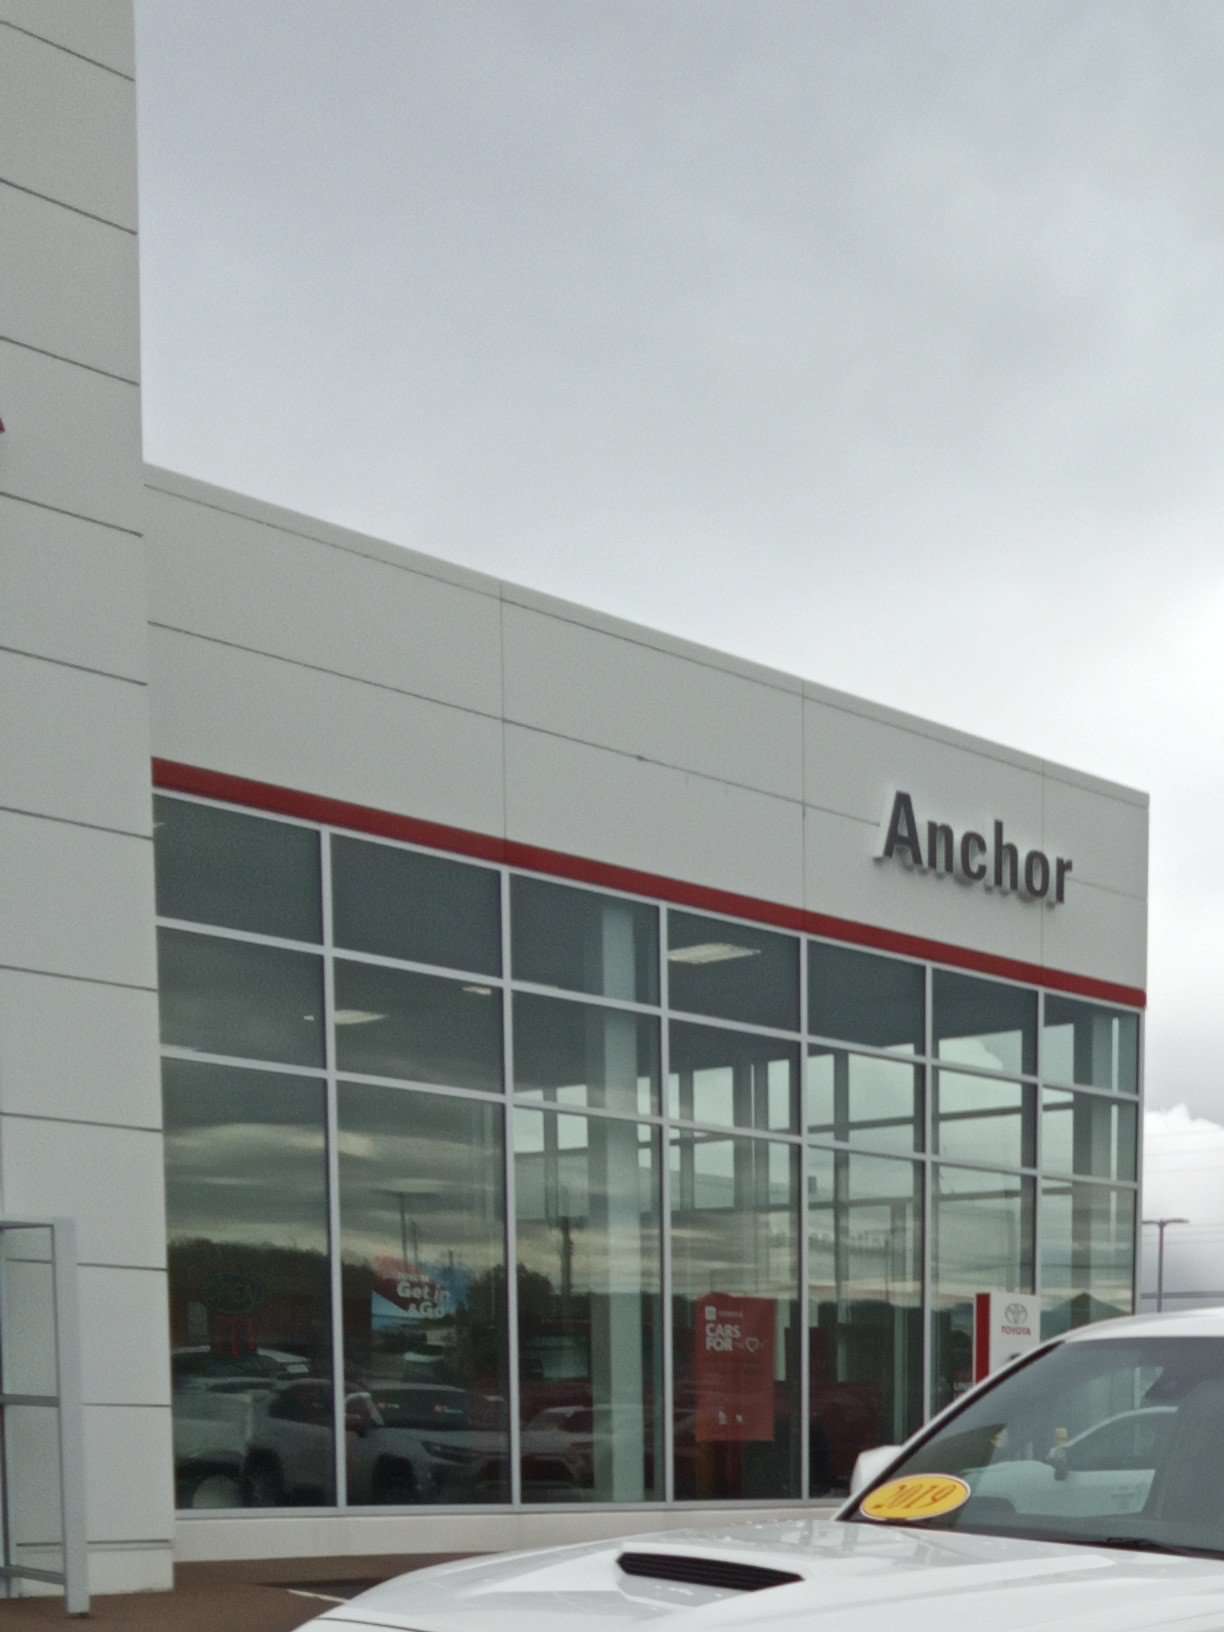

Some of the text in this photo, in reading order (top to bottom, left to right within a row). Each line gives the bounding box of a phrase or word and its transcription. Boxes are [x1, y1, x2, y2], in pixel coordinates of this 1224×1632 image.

[883, 790, 1073, 904] Anchor
[705, 1323, 741, 1338] CARS
[1001, 1326, 1031, 1336] TOYOTA
[705, 1336, 733, 1351] FOR
